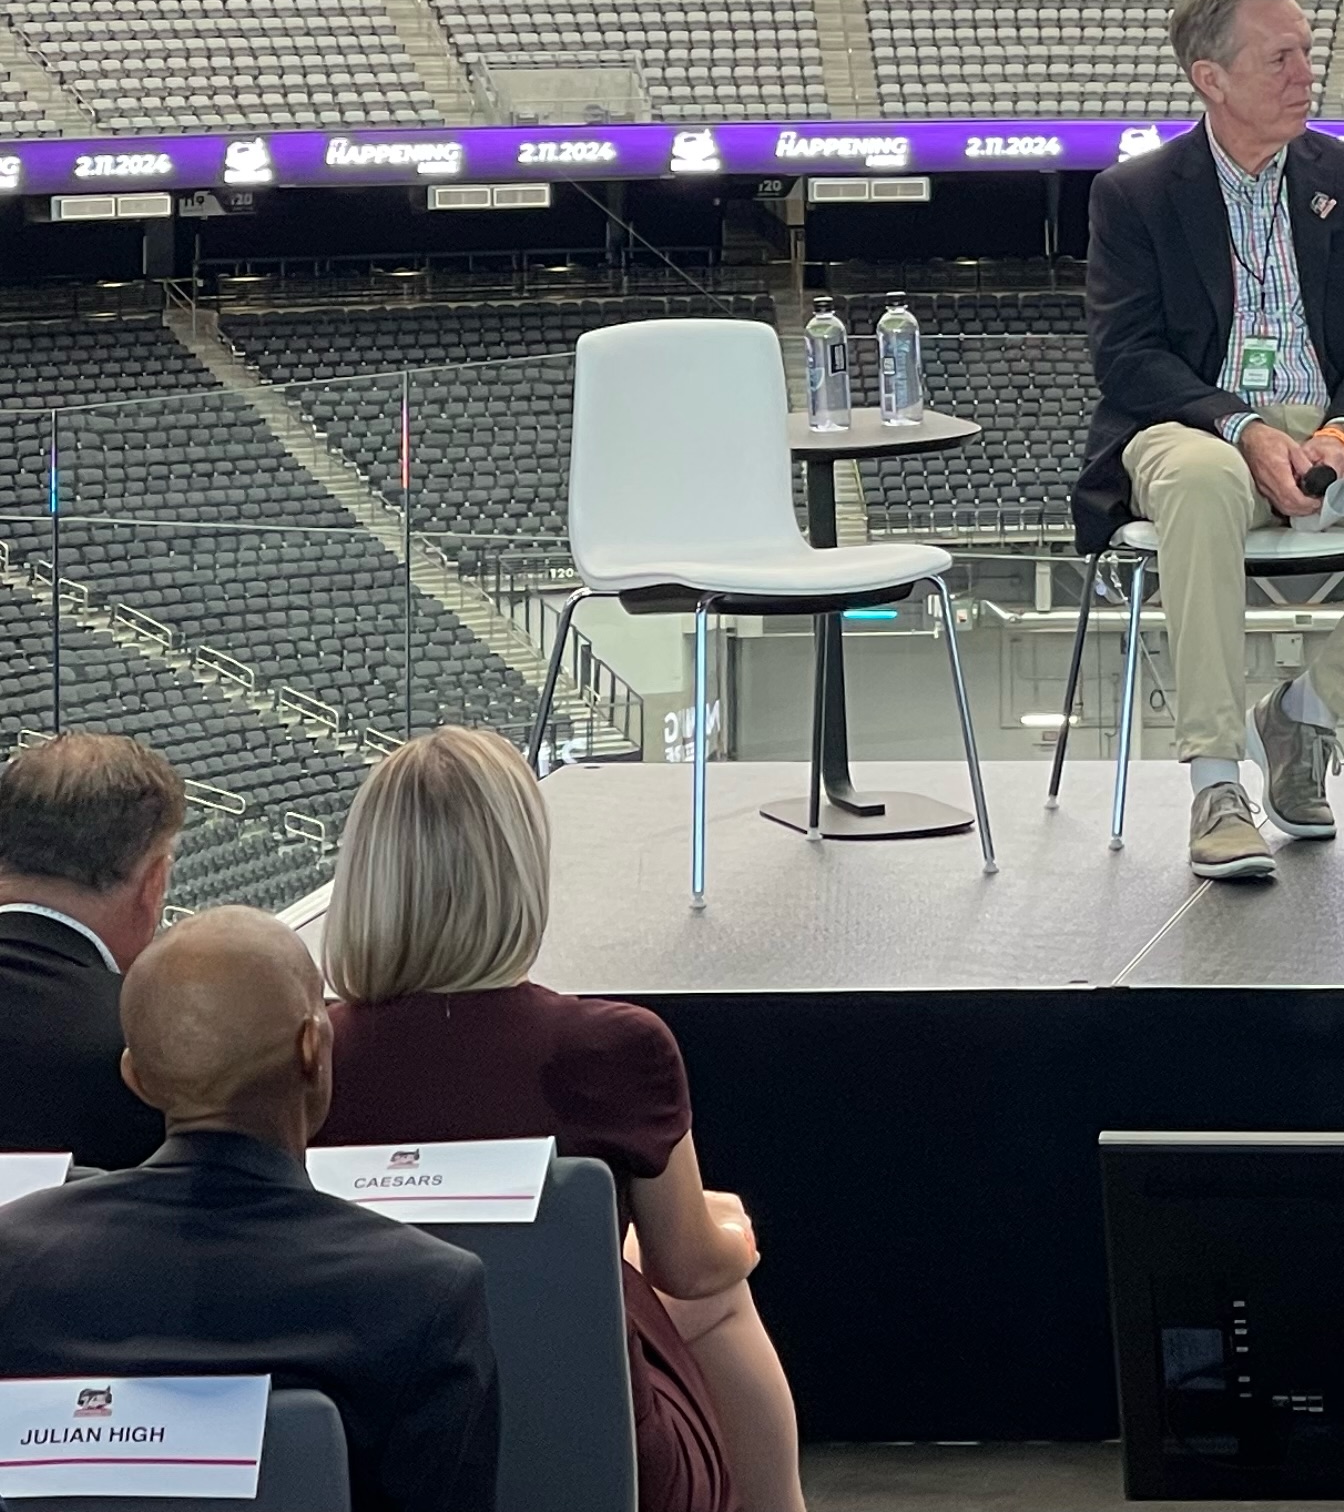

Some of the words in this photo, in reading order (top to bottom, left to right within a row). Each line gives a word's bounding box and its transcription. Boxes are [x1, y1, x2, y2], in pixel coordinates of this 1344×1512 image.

[550, 568, 575, 578] 120
[354, 1174, 443, 1189] CAESARS
[20, 1427, 102, 1445] JULIAN
[109, 1426, 166, 1443] HIGH
